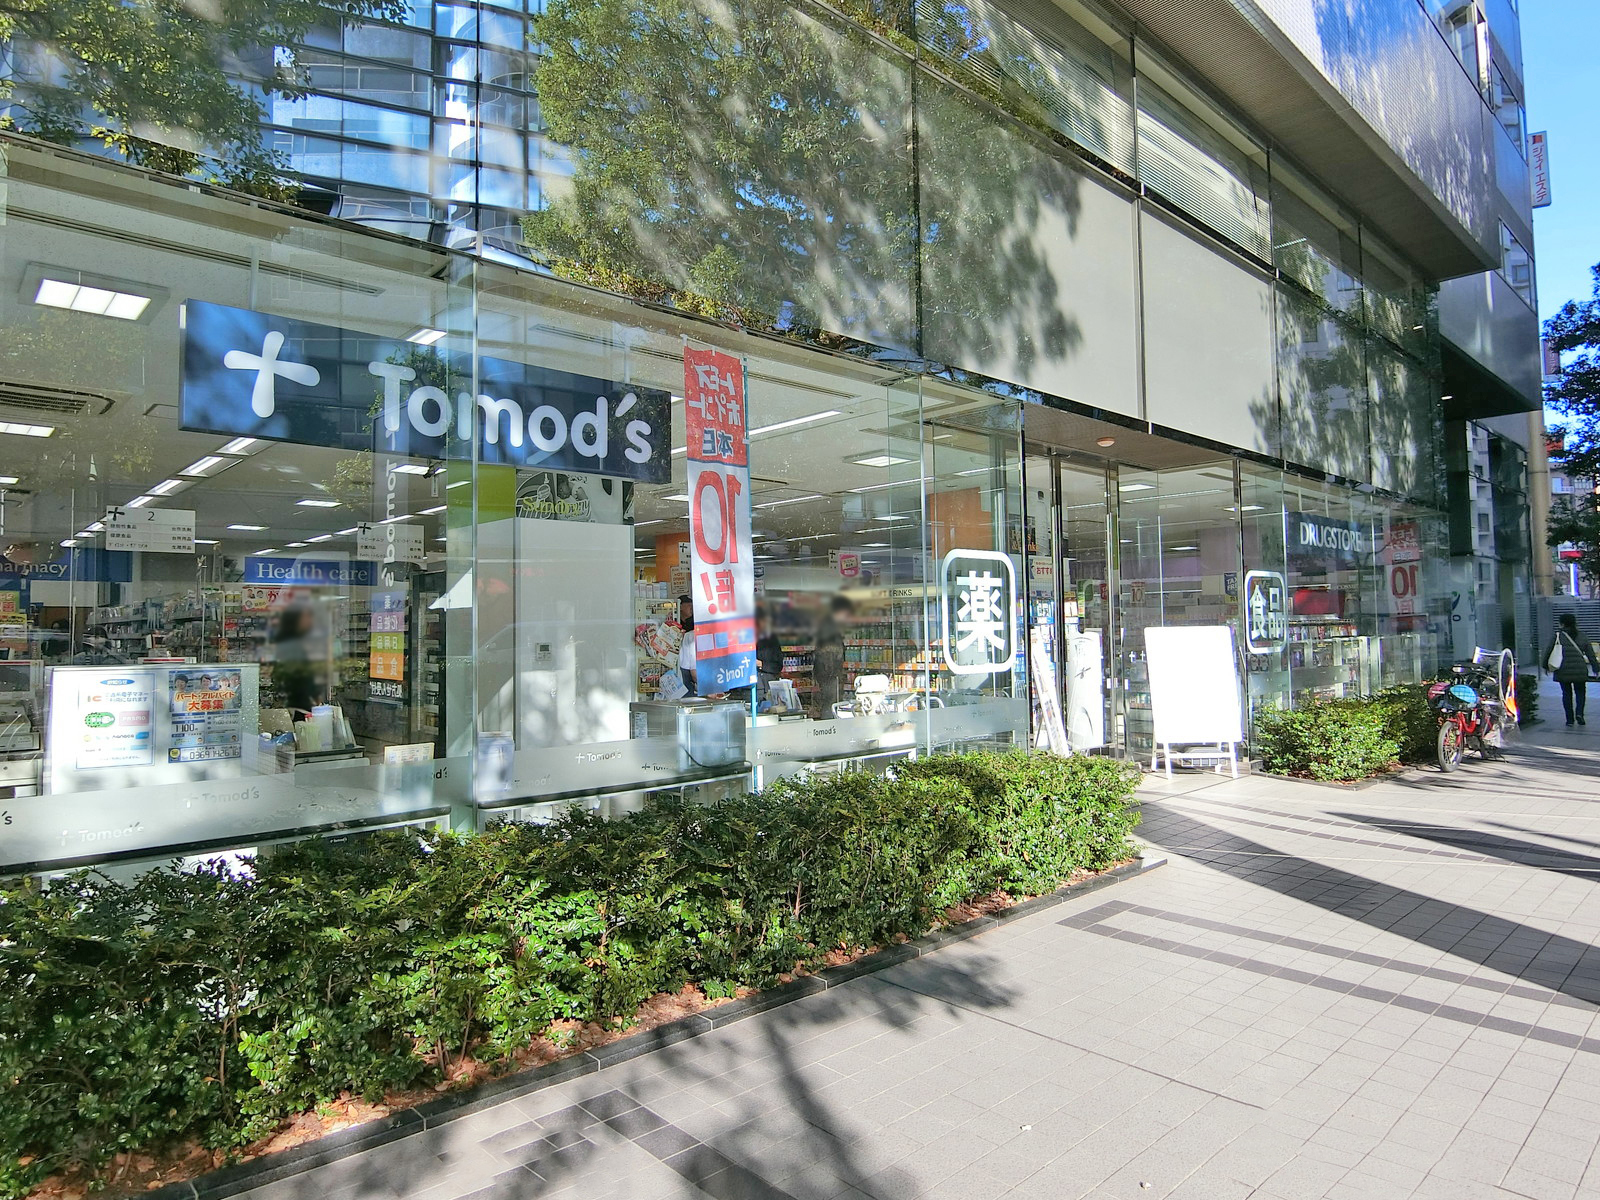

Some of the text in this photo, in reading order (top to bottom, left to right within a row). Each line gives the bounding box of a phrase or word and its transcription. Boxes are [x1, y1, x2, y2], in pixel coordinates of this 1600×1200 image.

[369, 361, 653, 464] Tomod's
[147, 511, 155, 521] 2
[1300, 521, 1363, 552] DRUGSTORE
[257, 563, 368, 581] Health care
[1036, 567, 1053, 575] おすす
[956, 570, 1005, 653] 薬
